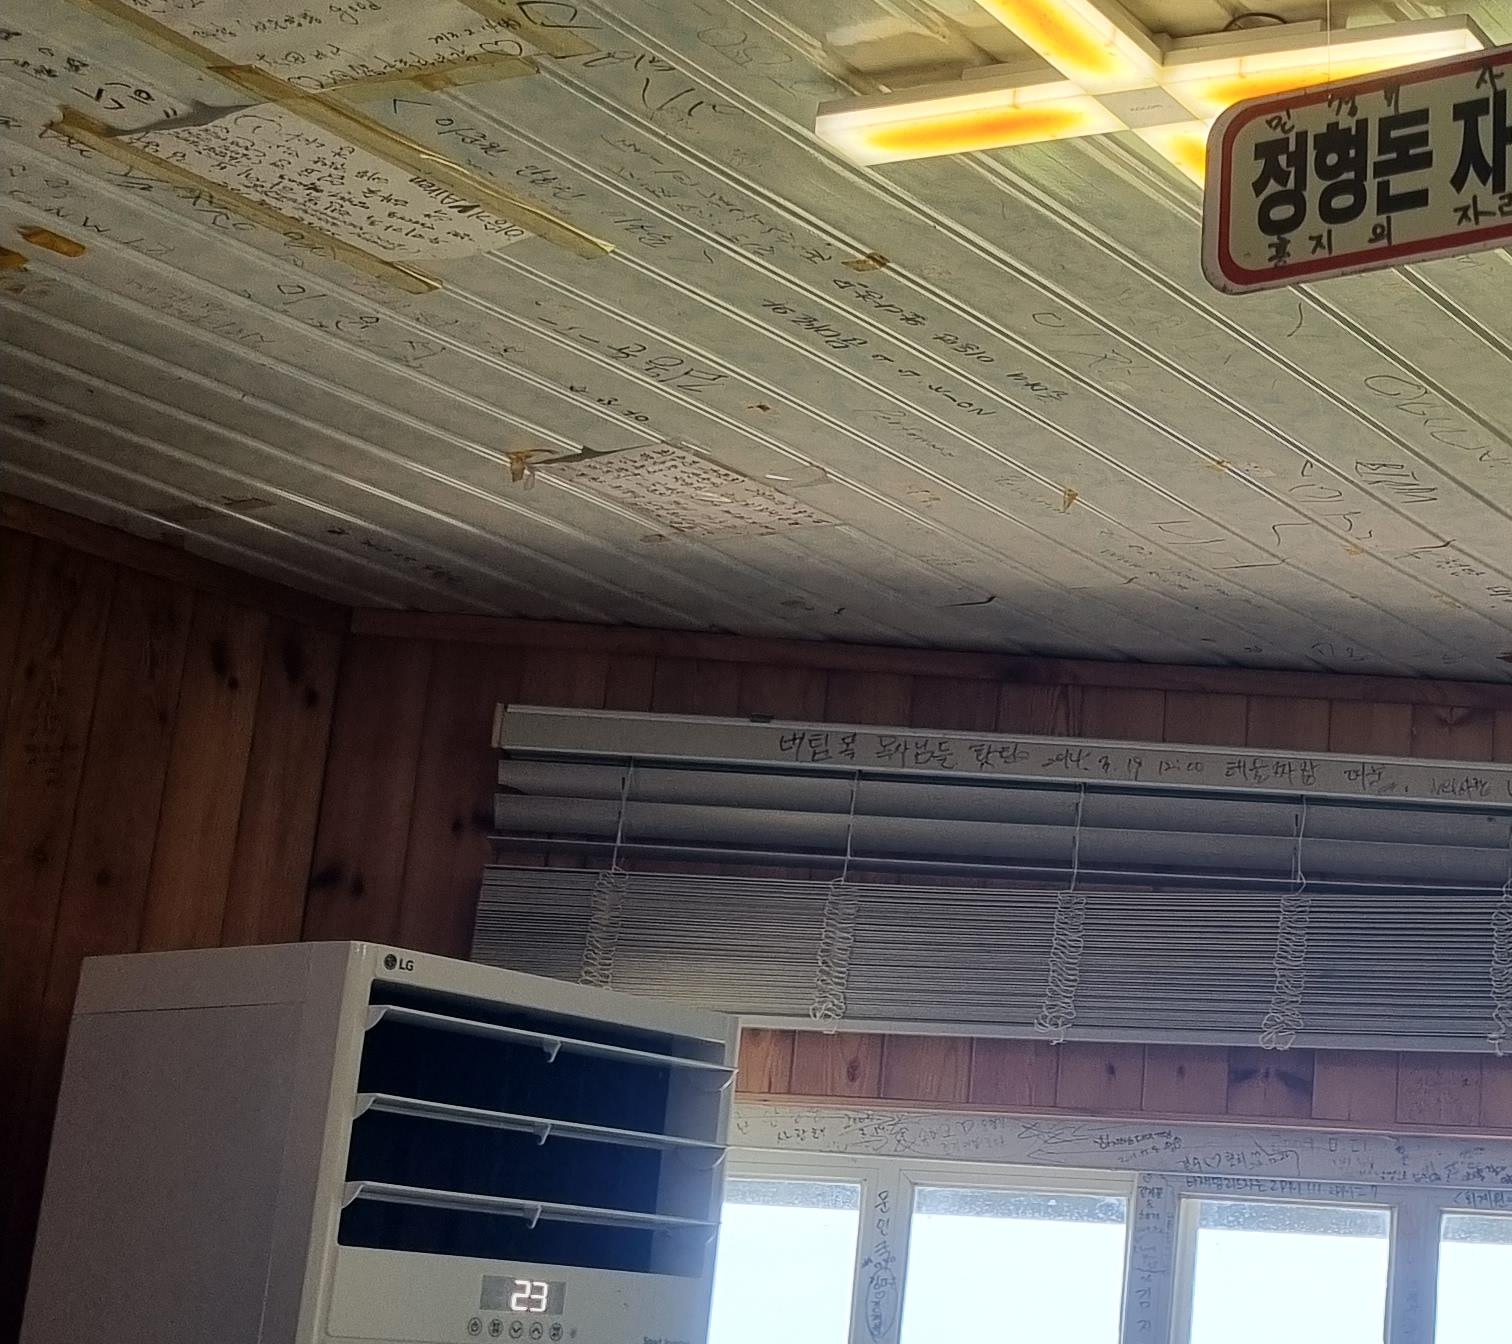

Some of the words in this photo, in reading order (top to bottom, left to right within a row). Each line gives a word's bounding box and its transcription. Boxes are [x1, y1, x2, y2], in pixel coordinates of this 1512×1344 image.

[1252, 107, 1435, 236] 정형돈
[398, 958, 415, 973] LG
[510, 1279, 549, 1313] 23
